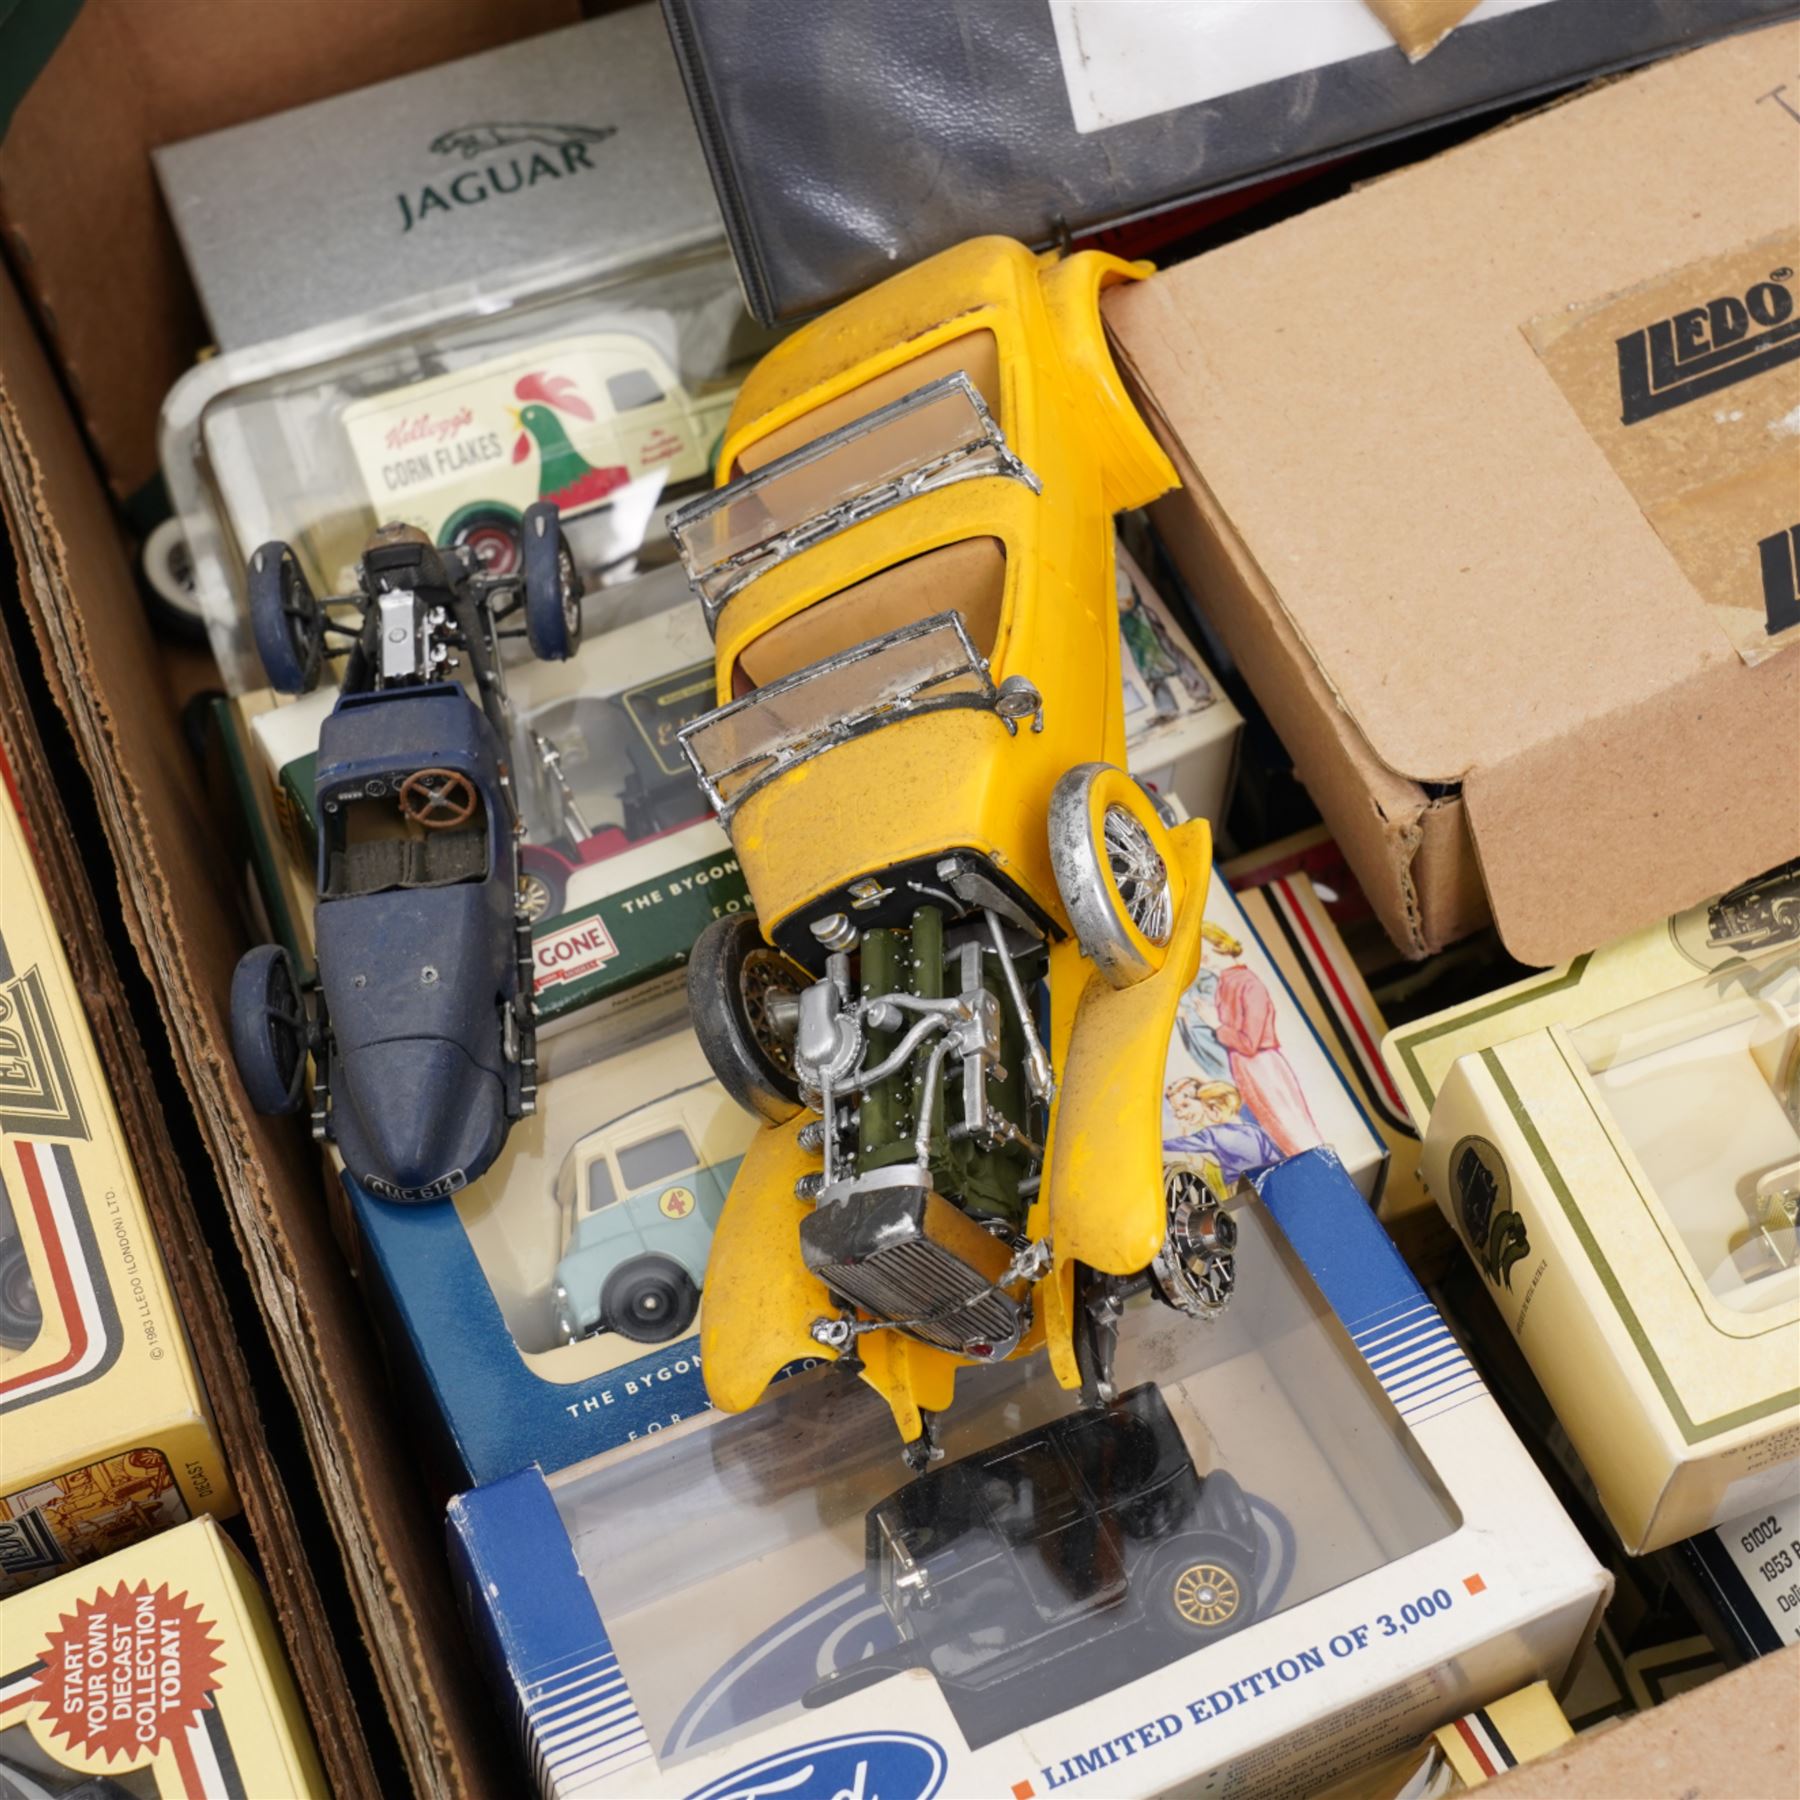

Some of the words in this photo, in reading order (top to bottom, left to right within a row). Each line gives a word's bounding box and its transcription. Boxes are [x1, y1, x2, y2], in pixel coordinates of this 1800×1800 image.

[397, 139, 596, 233] JAGUAR
[385, 406, 473, 450] Kellogg's
[382, 453, 434, 491] CORN
[434, 431, 503, 476] FLAKES
[621, 889, 664, 915] THE
[669, 860, 739, 897] BYGON
[538, 928, 606, 968] GONE
[130, 1277, 151, 1317] LLEDO
[143, 1320, 160, 1346] 1983
[566, 1390, 615, 1419] THE
[1740, 1515, 1783, 1553] 61002
[1759, 1550, 1793, 1582] 1953
[87, 1613, 107, 1668] OWN
[160, 1618, 181, 1713] TODAY!
[64, 1641, 84, 1713] START
[112, 1624, 132, 1720] DIECAST
[136, 1595, 156, 1742] COLLECTION
[1041, 1713, 1183, 1790] LIMITED
[1186, 1646, 1326, 1725] EDITION
[1329, 1624, 1369, 1658] OF
[1376, 1588, 1453, 1634] 3,000
[87, 1674, 107, 1738] YOUR
